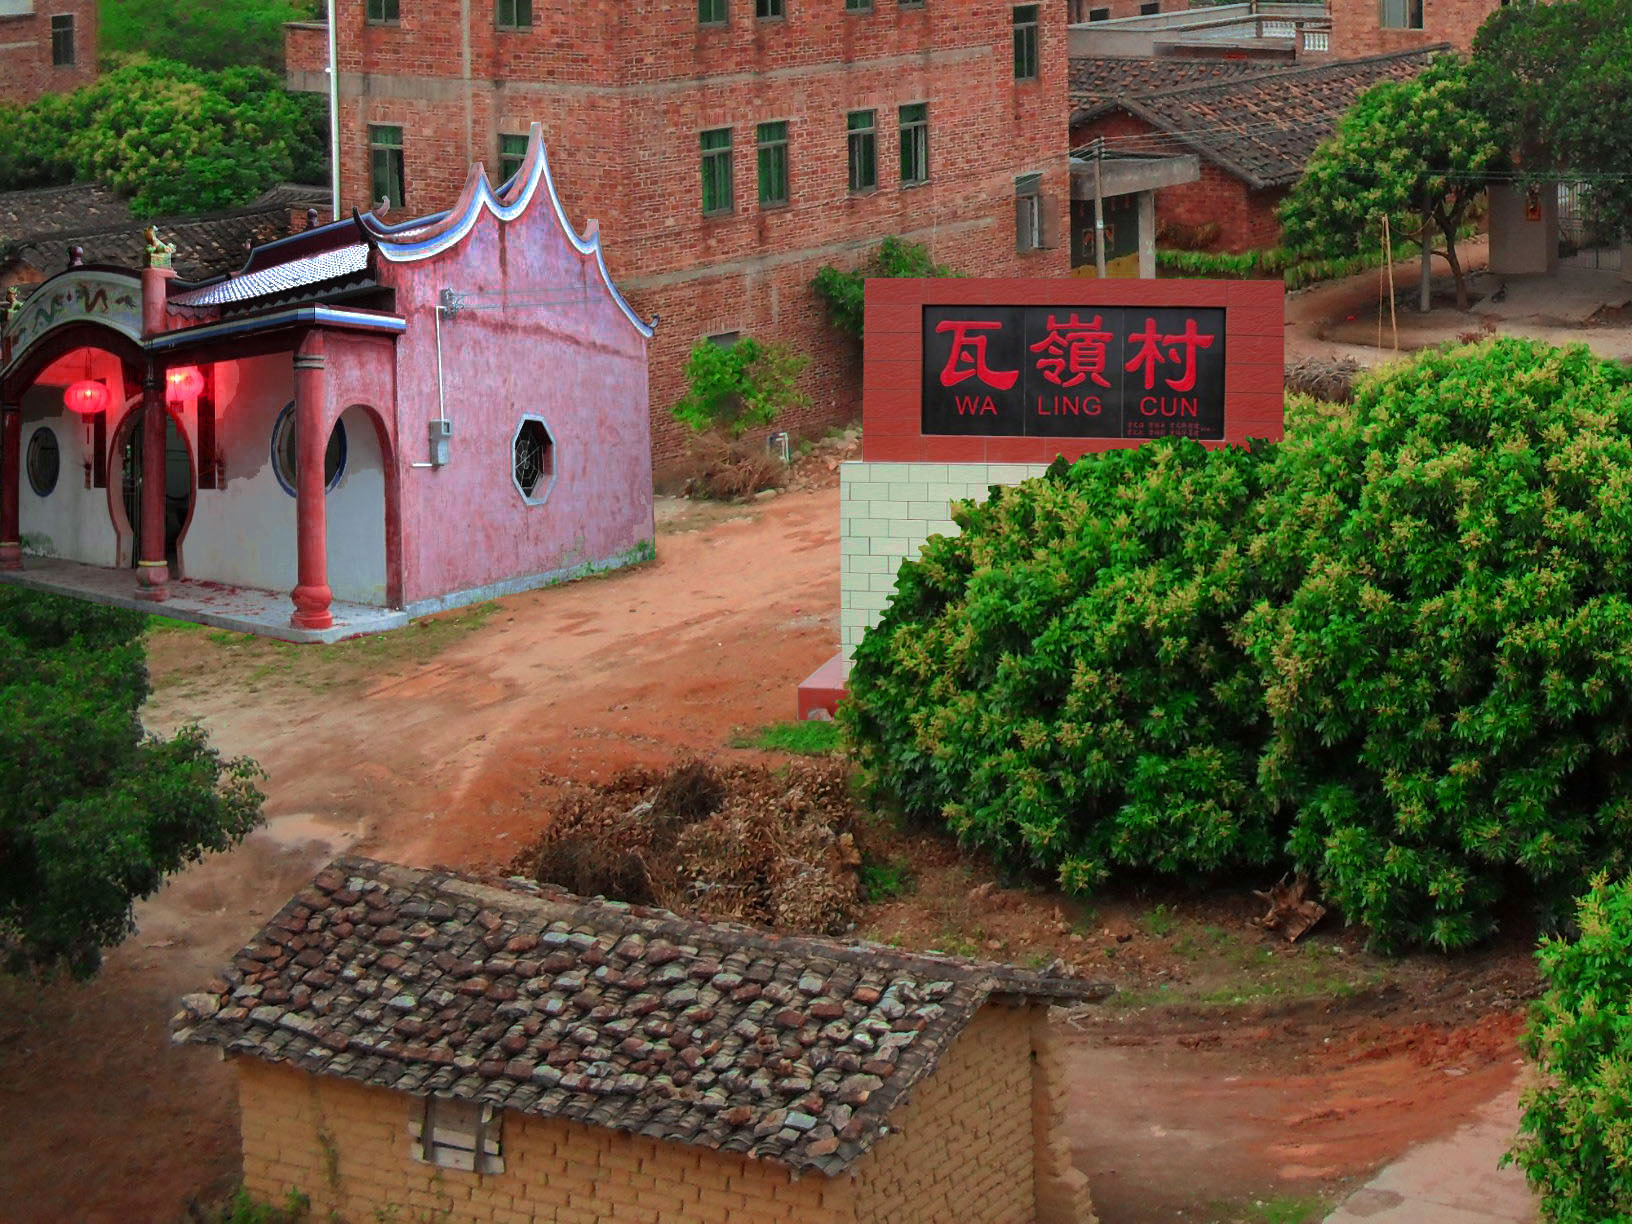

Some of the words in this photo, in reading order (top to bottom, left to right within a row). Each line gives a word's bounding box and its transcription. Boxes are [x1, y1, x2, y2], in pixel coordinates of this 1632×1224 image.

[935, 313, 1215, 392] 瓦嶺村
[954, 395, 998, 416] WA
[1037, 395, 1103, 417] LING
[1139, 396, 1198, 417] CUN
